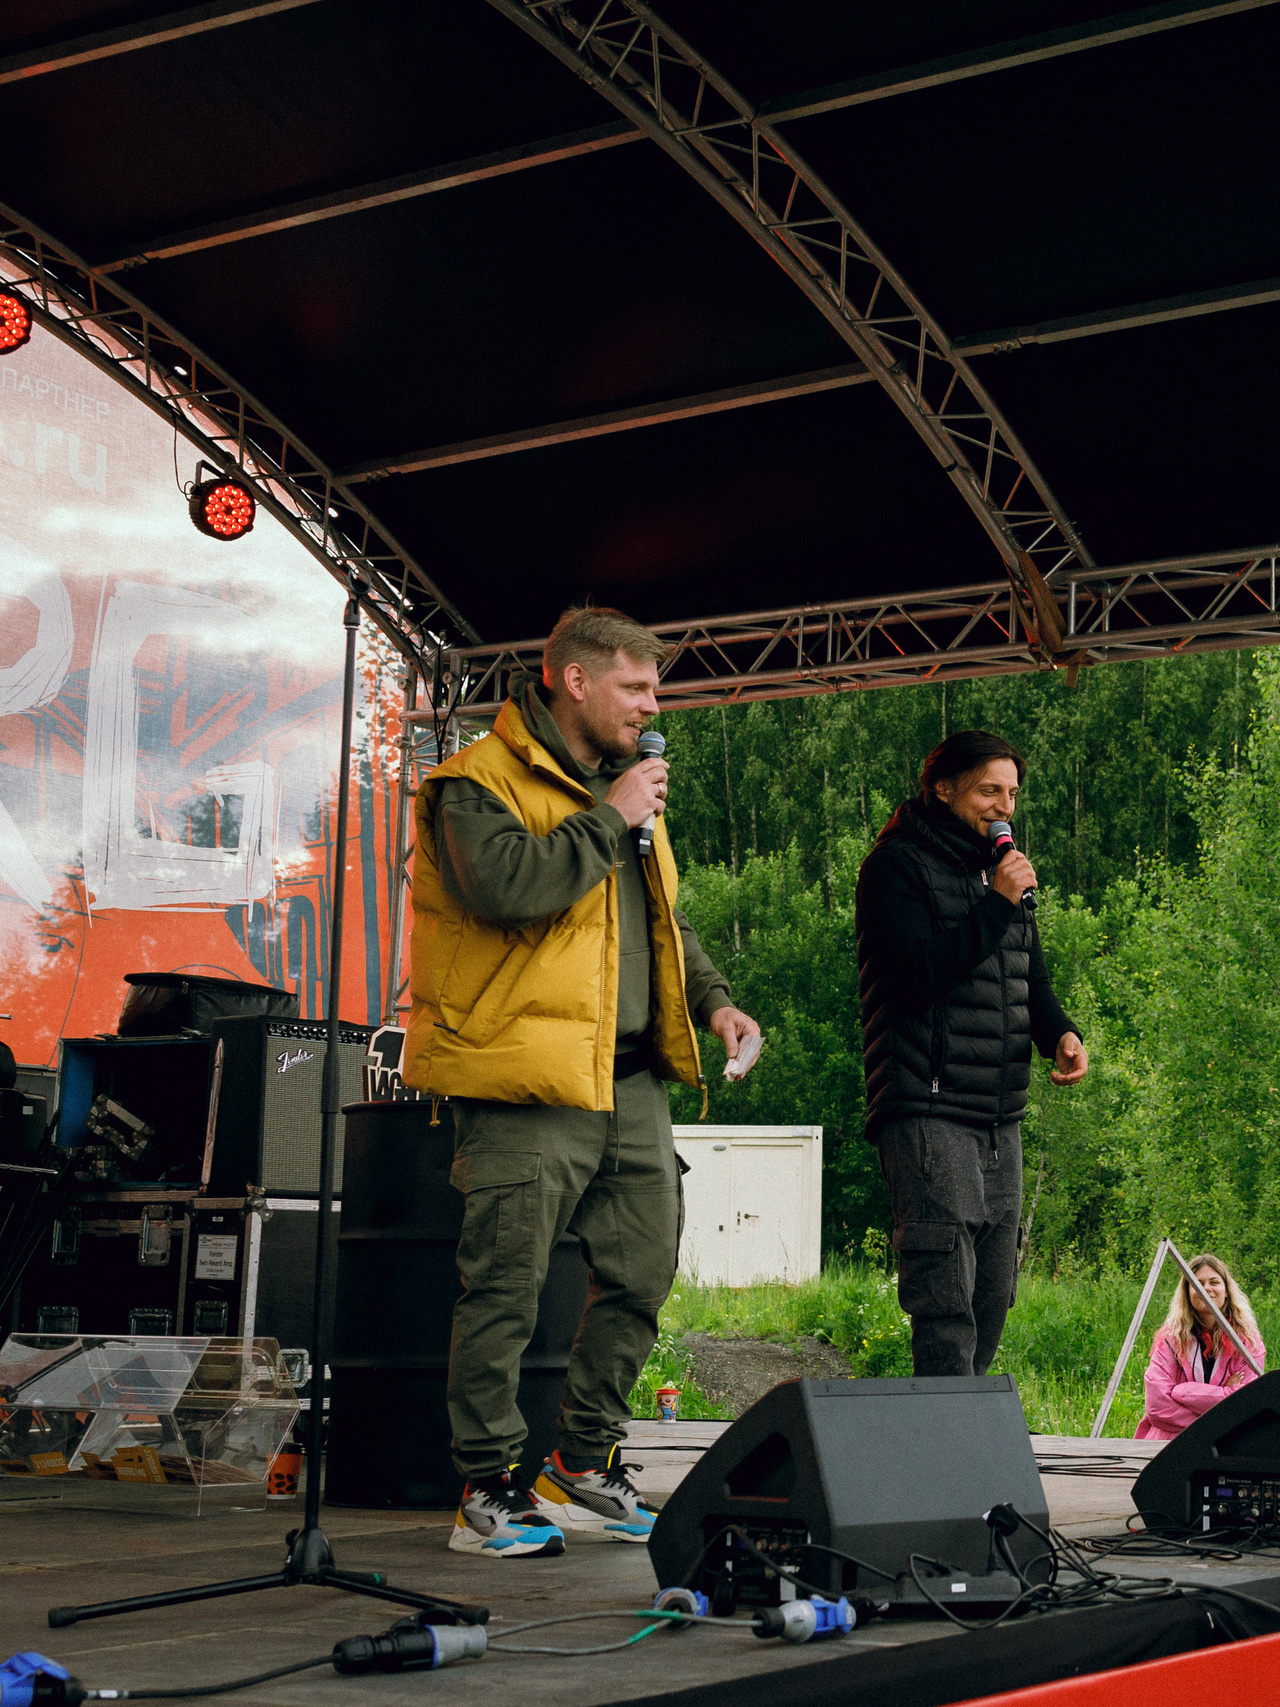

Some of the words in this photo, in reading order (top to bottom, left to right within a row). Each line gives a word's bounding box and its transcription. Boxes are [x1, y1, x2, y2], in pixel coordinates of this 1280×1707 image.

[2, 366, 110, 420] ПАРТНЕР
[0, 420, 107, 494] .ru
[277, 1048, 314, 1074] Fender
